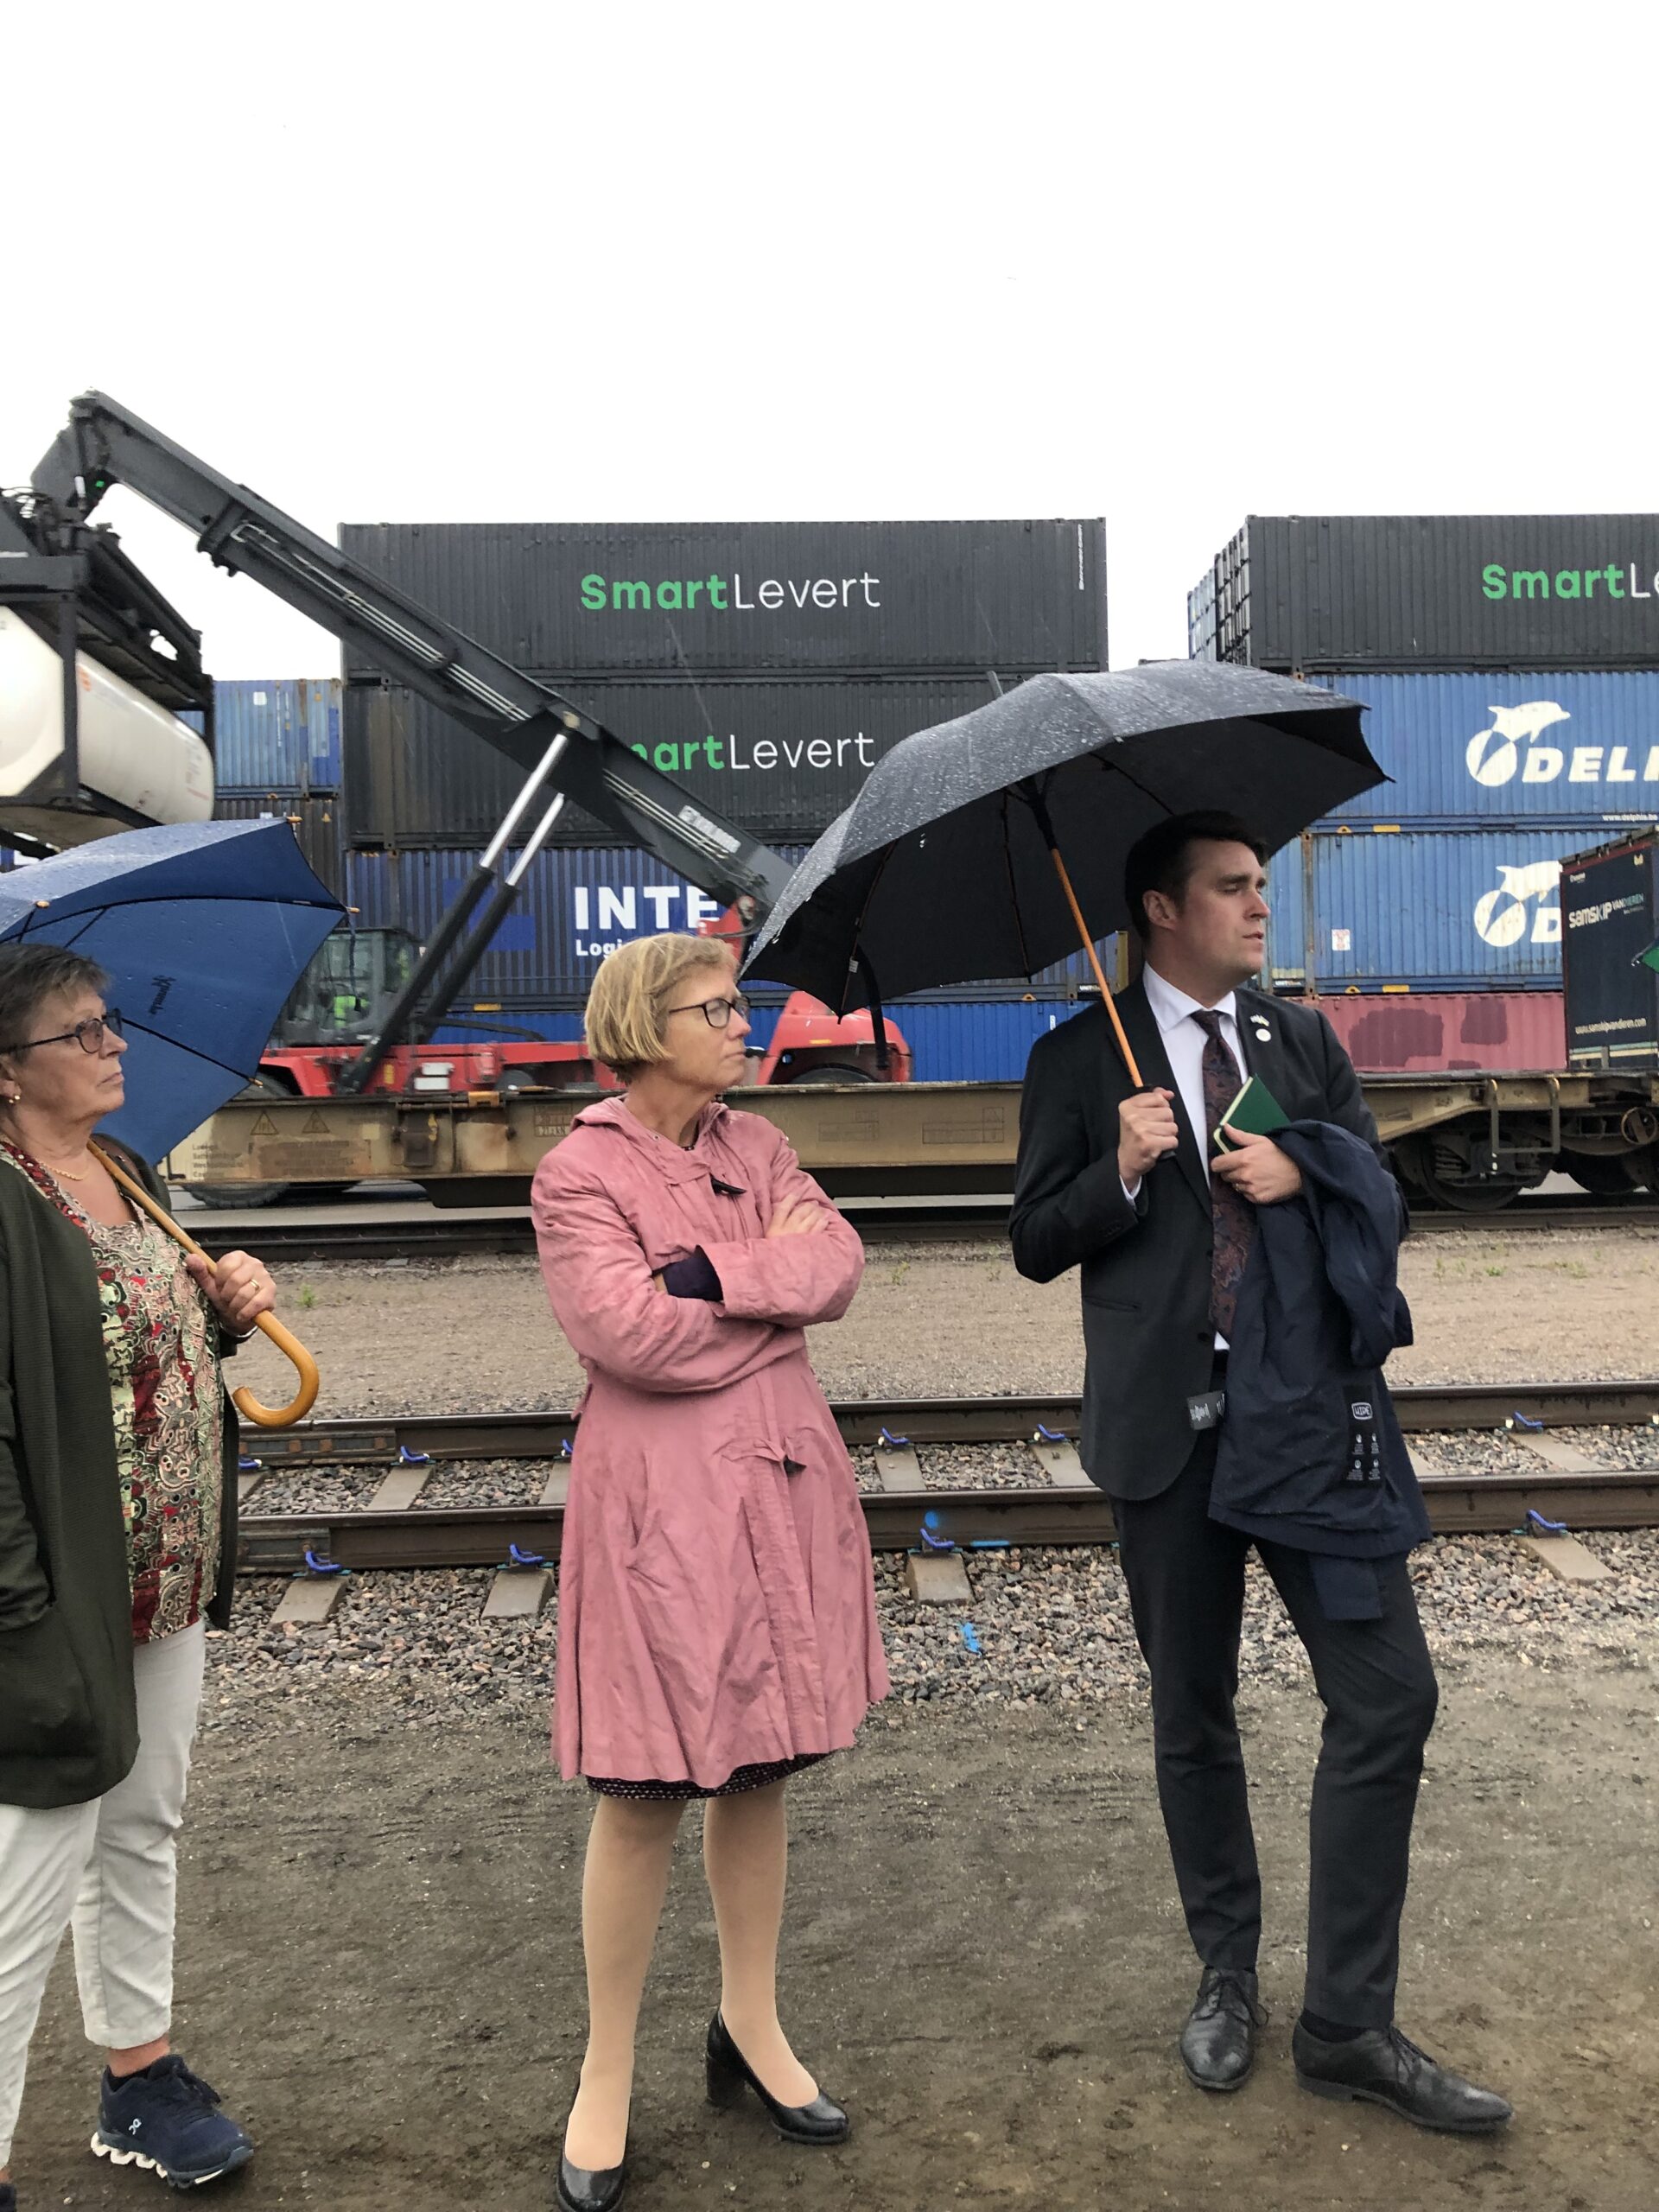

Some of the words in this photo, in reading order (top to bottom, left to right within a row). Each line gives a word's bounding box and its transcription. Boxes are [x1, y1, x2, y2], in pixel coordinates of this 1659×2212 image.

[580, 572, 881, 610] SmartLevert
[1482, 562, 1659, 600] SmartL
[630, 732, 876, 772] artLevert
